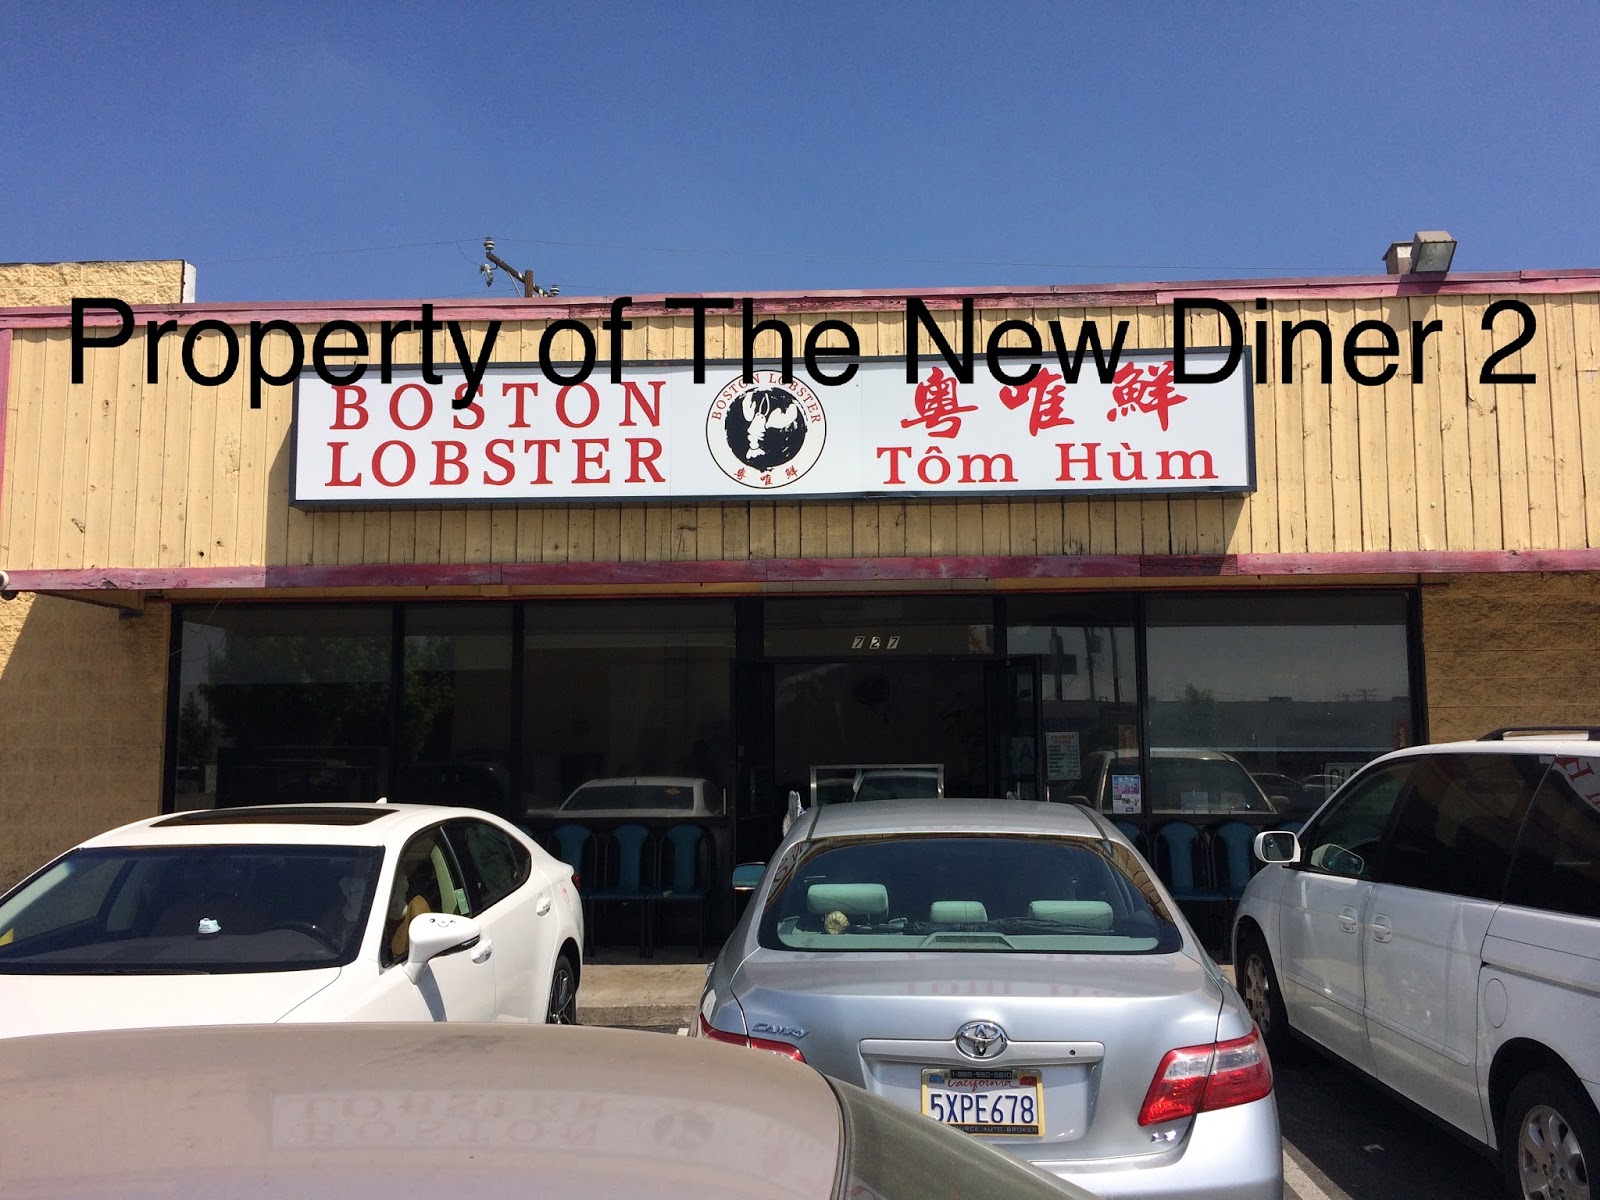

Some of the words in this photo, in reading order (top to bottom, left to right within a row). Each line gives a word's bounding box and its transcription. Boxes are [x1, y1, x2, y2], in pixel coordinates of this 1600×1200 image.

[329, 381, 666, 431] BOSTON
[325, 438, 666, 487] LOBSTER
[876, 445, 1019, 485] Tôm
[1054, 442, 1219, 481] Hùm
[947, 1080, 1018, 1091] California
[930, 1093, 1034, 1124] 5XPE678
